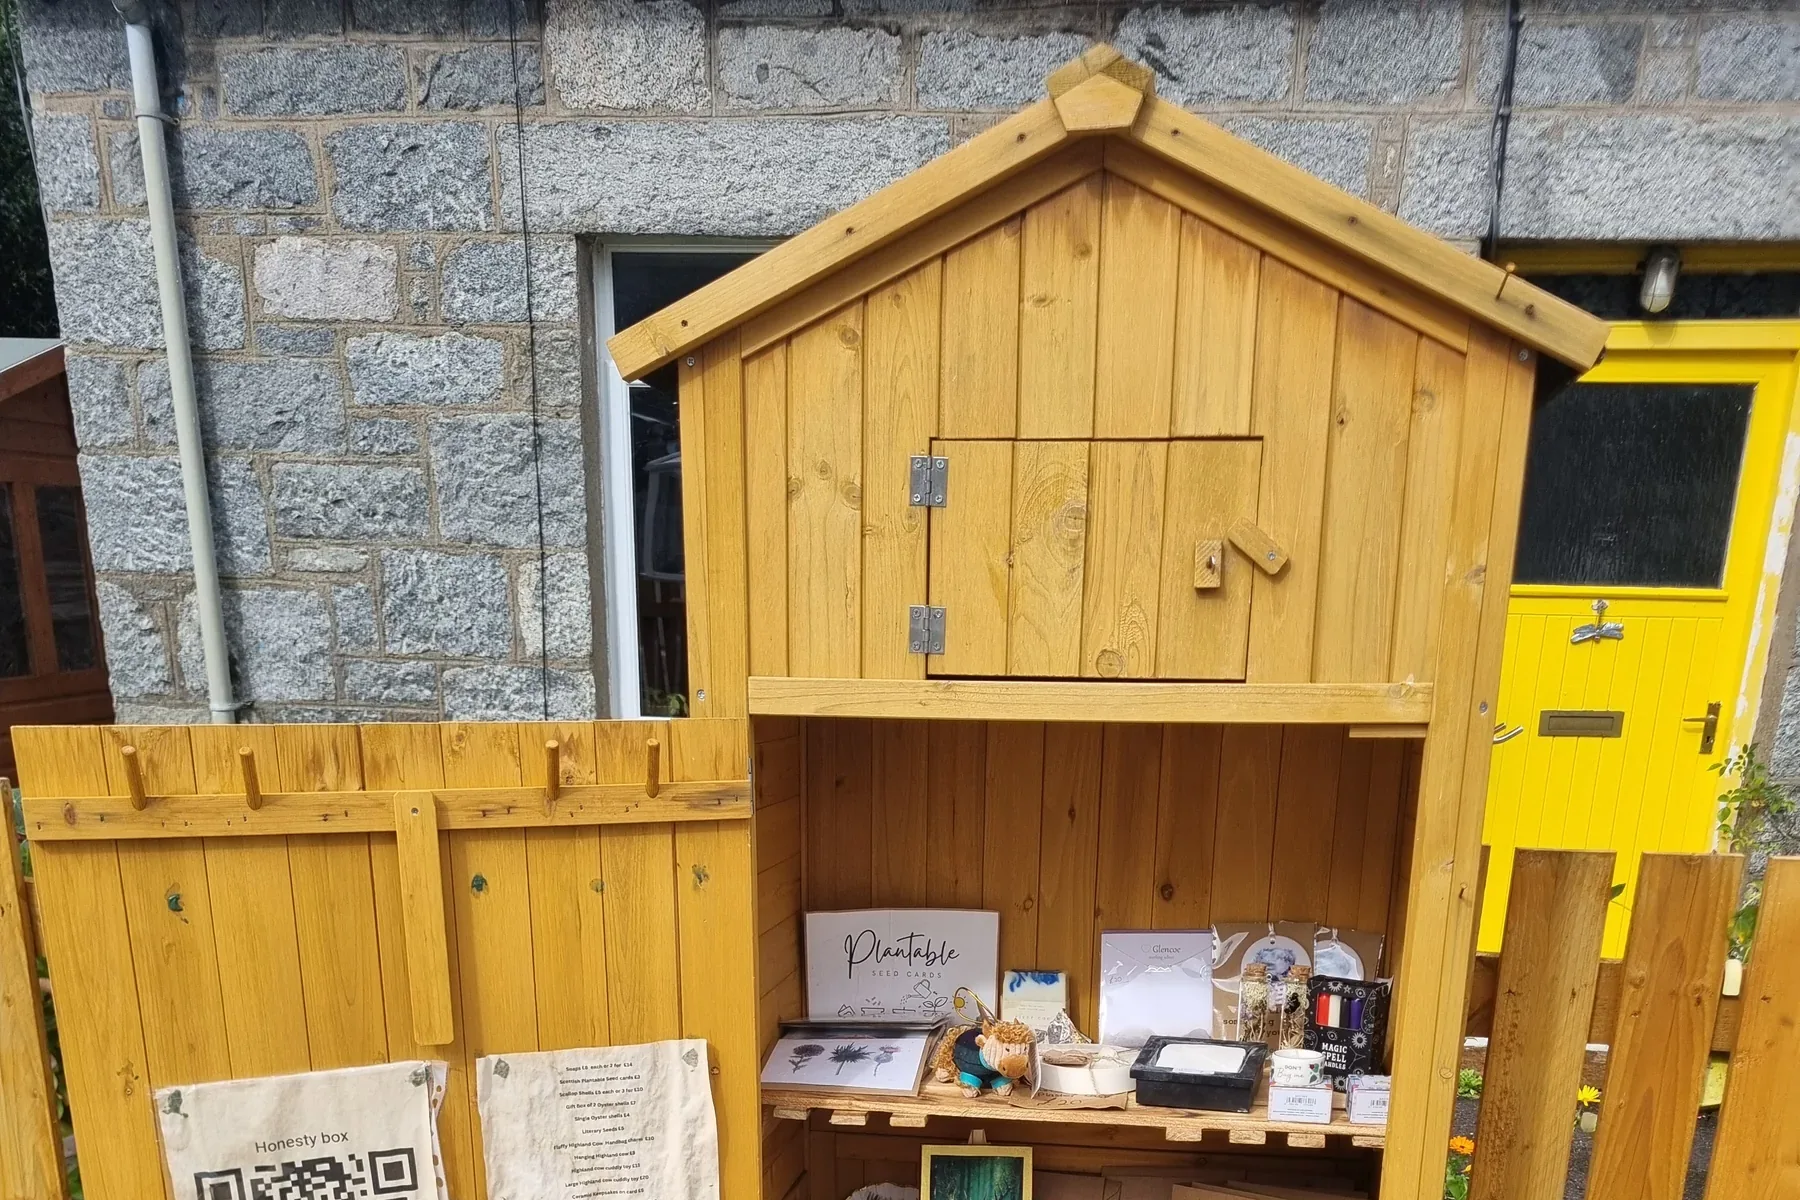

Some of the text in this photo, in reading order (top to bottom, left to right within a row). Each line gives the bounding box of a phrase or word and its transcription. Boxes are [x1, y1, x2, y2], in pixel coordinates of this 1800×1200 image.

[844, 929, 960, 980] Plantable
[1152, 944, 1181, 954] Glencoe
[871, 969, 942, 979] SEED CARDS
[1321, 1041, 1348, 1054] MAGIC
[1320, 1051, 1347, 1064] SPELL
[1323, 1060, 1346, 1070] ANDLES
[255, 1131, 349, 1154] Honesty box
